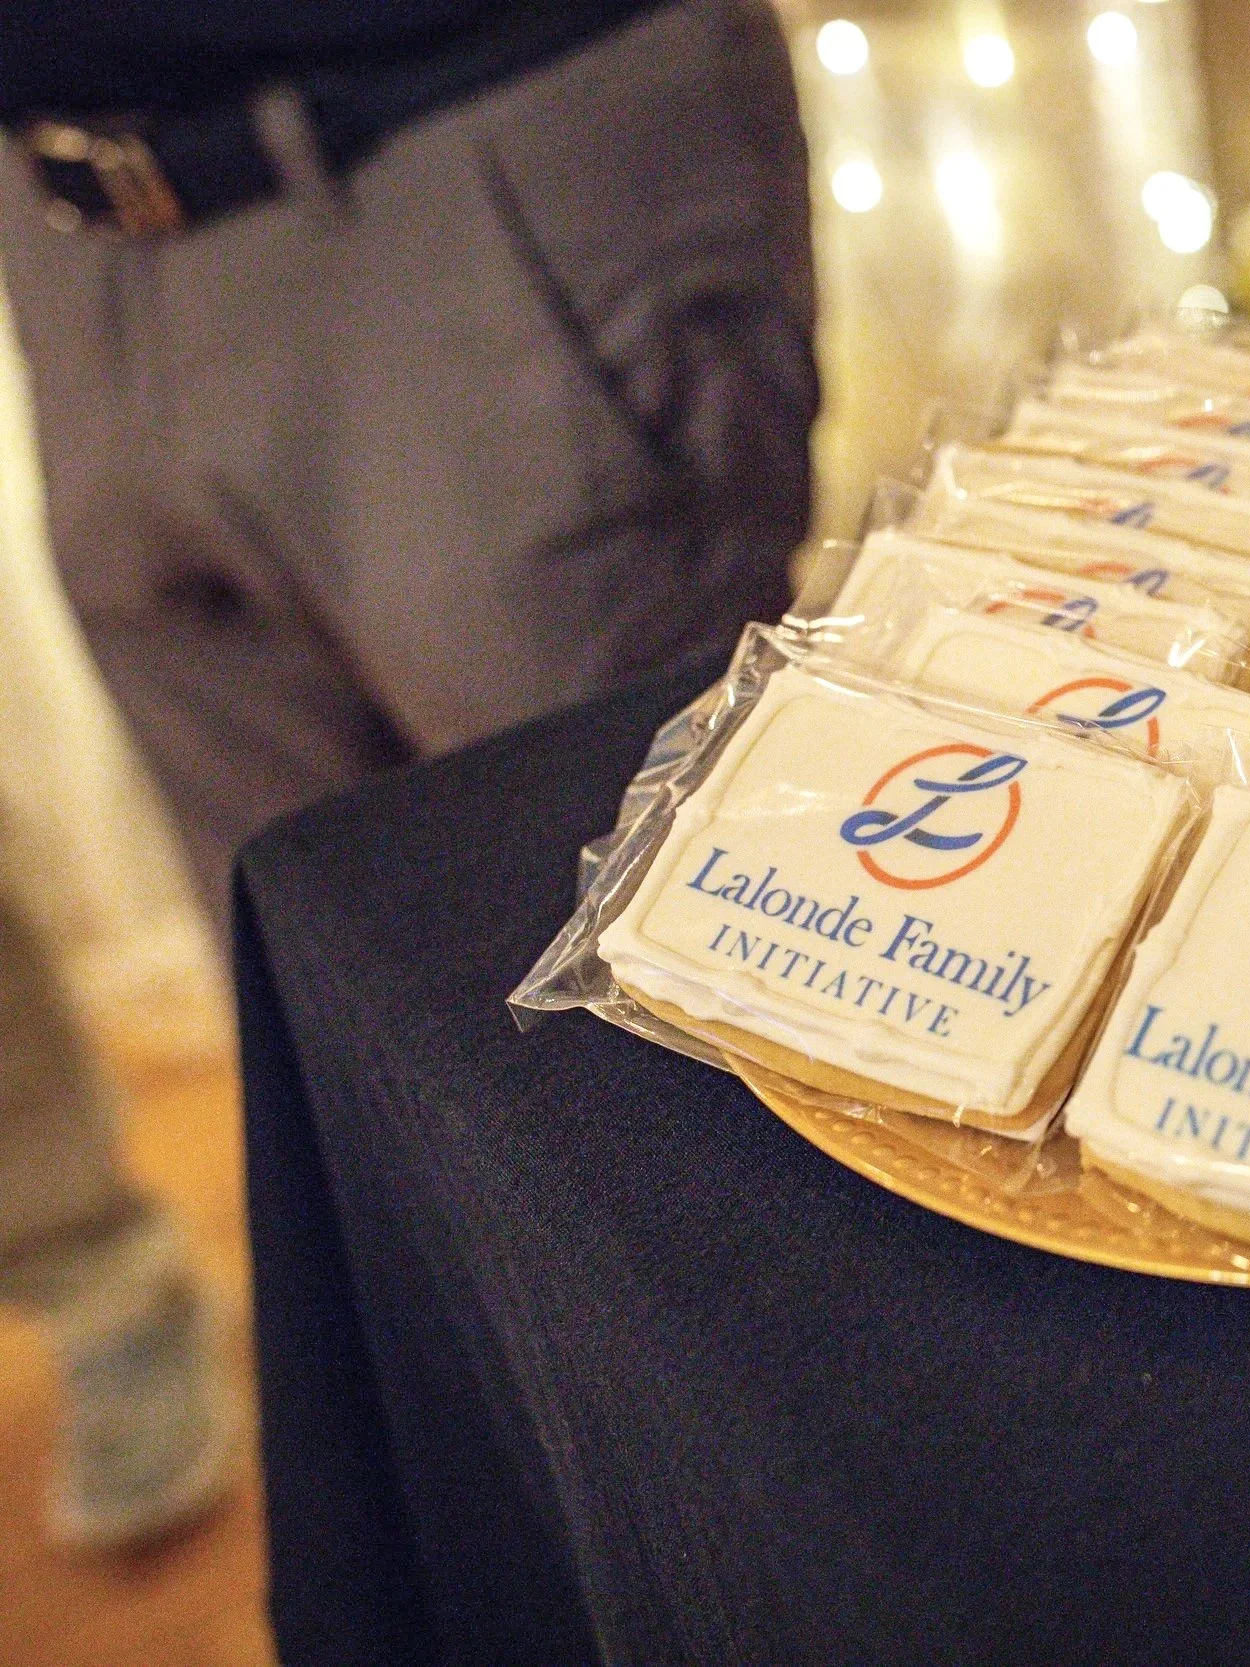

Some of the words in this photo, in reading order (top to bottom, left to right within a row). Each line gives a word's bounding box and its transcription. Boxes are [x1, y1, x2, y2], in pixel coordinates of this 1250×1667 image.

[686, 847, 874, 948] Lalonde
[884, 913, 1052, 1017] Family
[707, 923, 961, 1038] INITIATIVE
